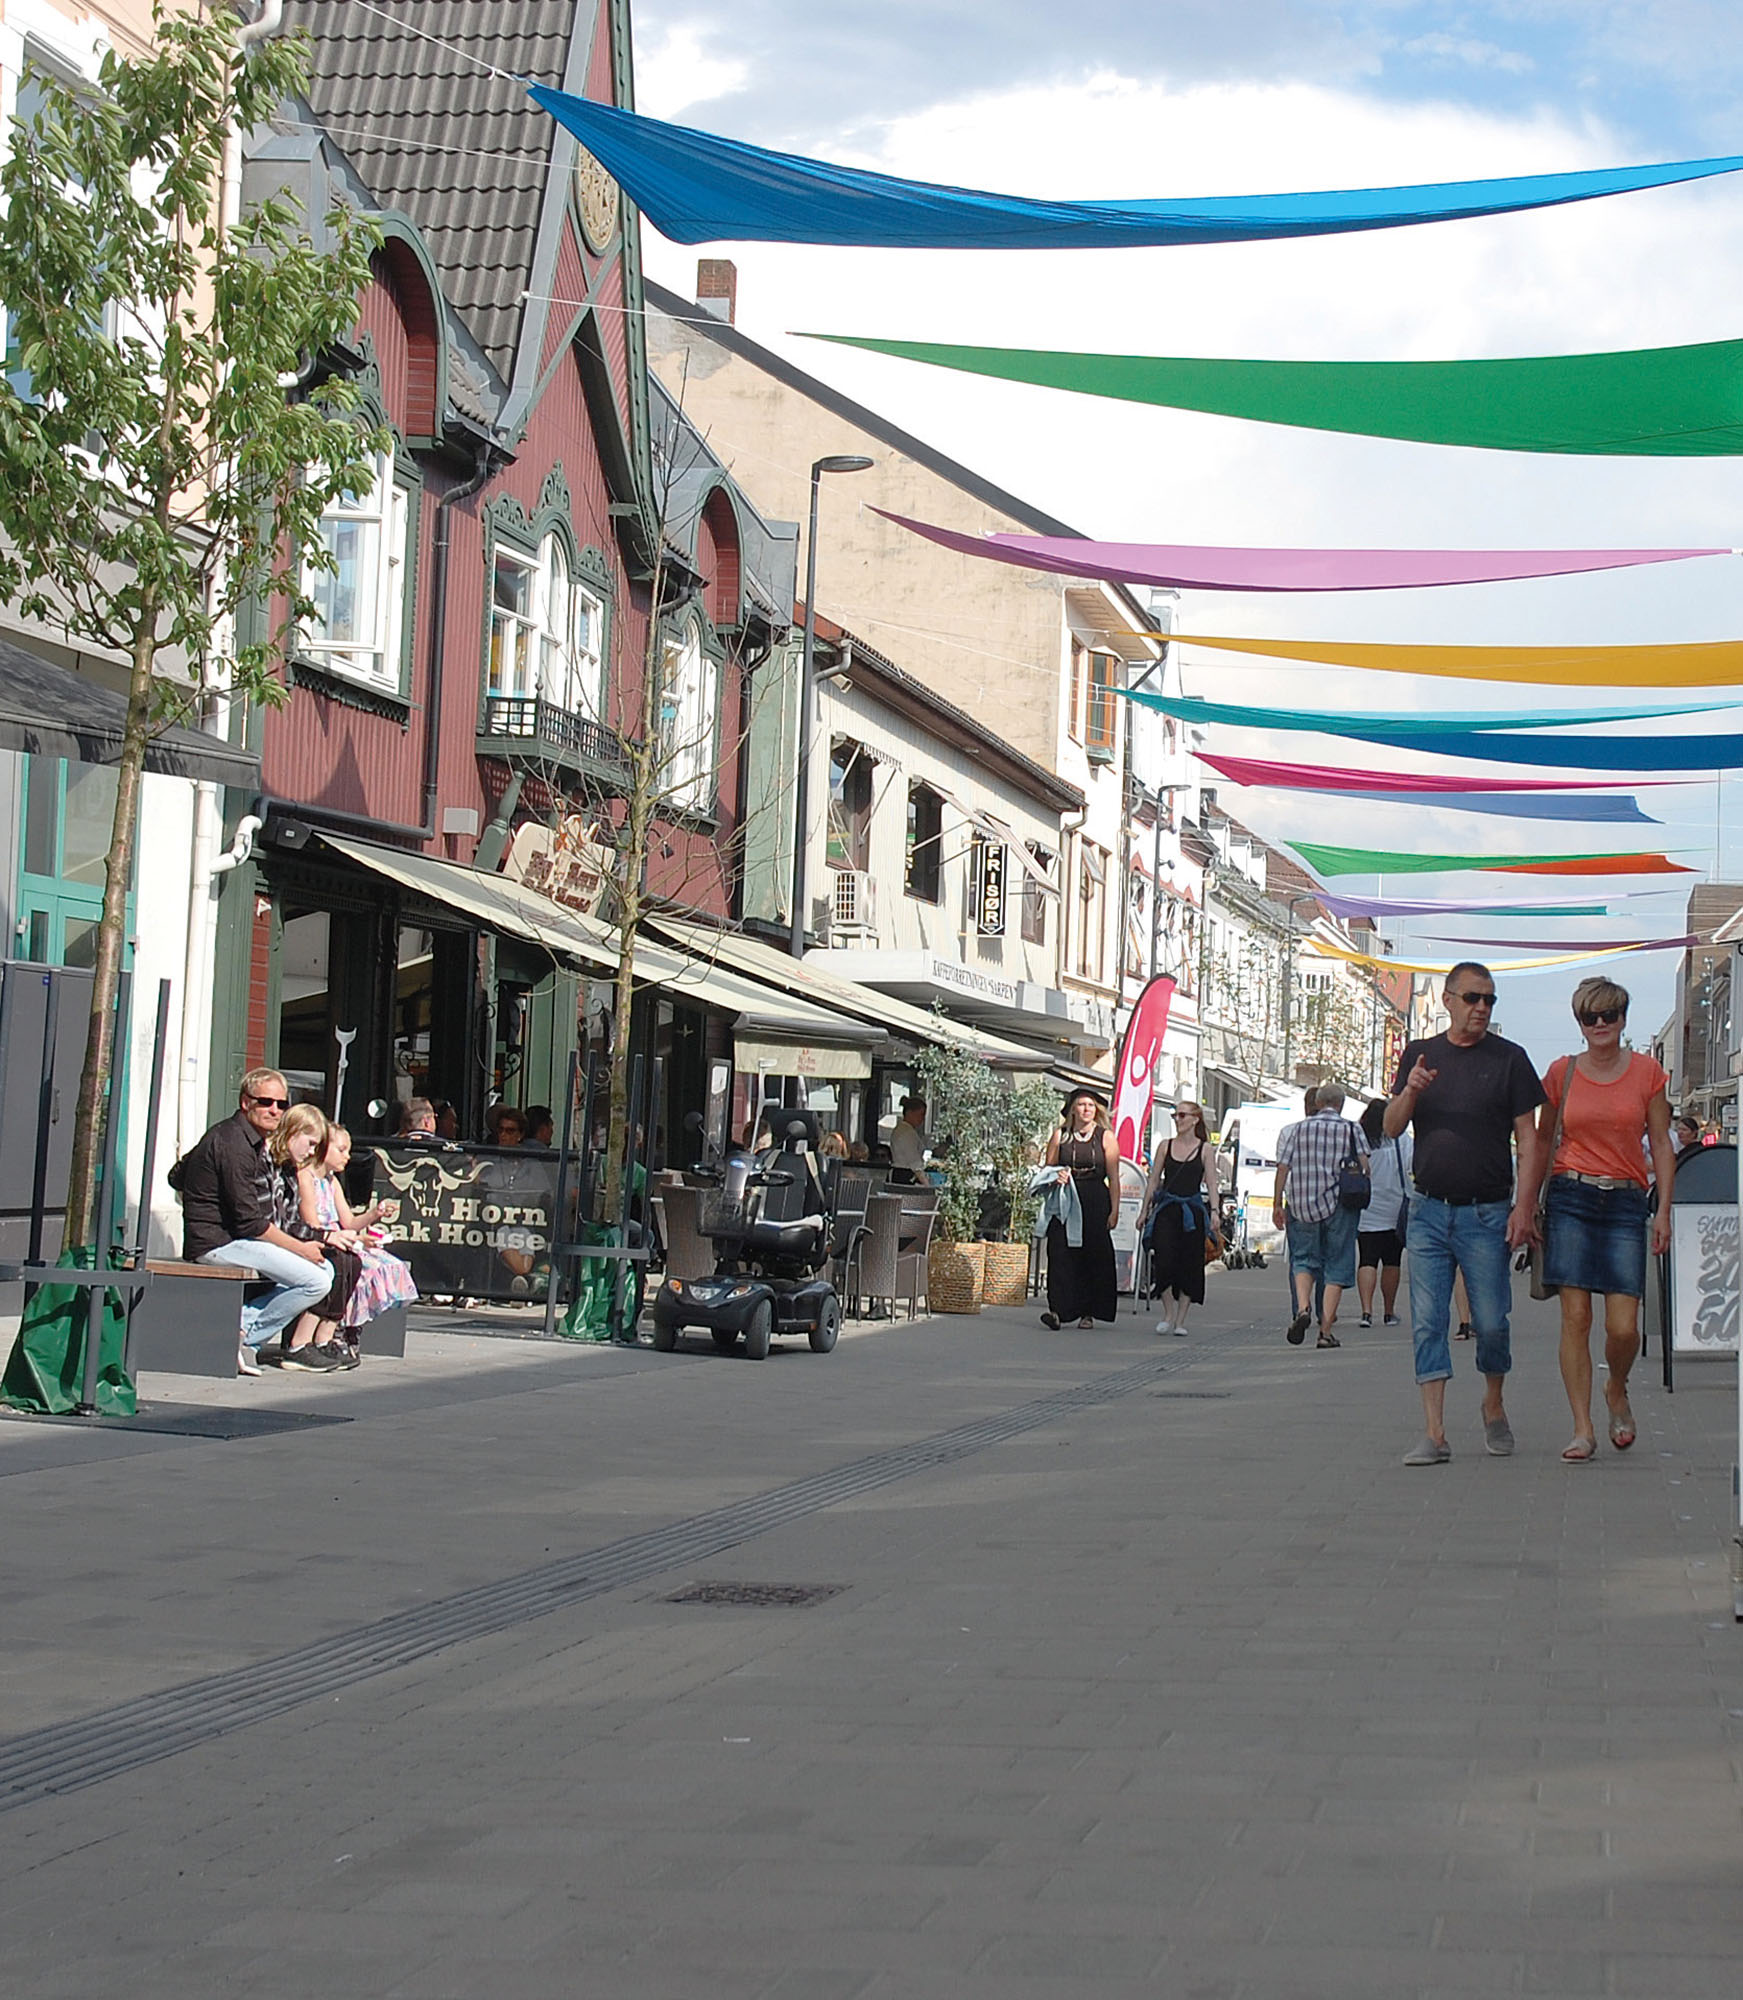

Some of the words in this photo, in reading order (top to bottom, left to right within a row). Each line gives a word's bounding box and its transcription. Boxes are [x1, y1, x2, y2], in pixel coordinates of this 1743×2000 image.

[984, 846, 1000, 923] FRISØR
[450, 1197, 547, 1226] Horn
[438, 1222, 546, 1250] House
